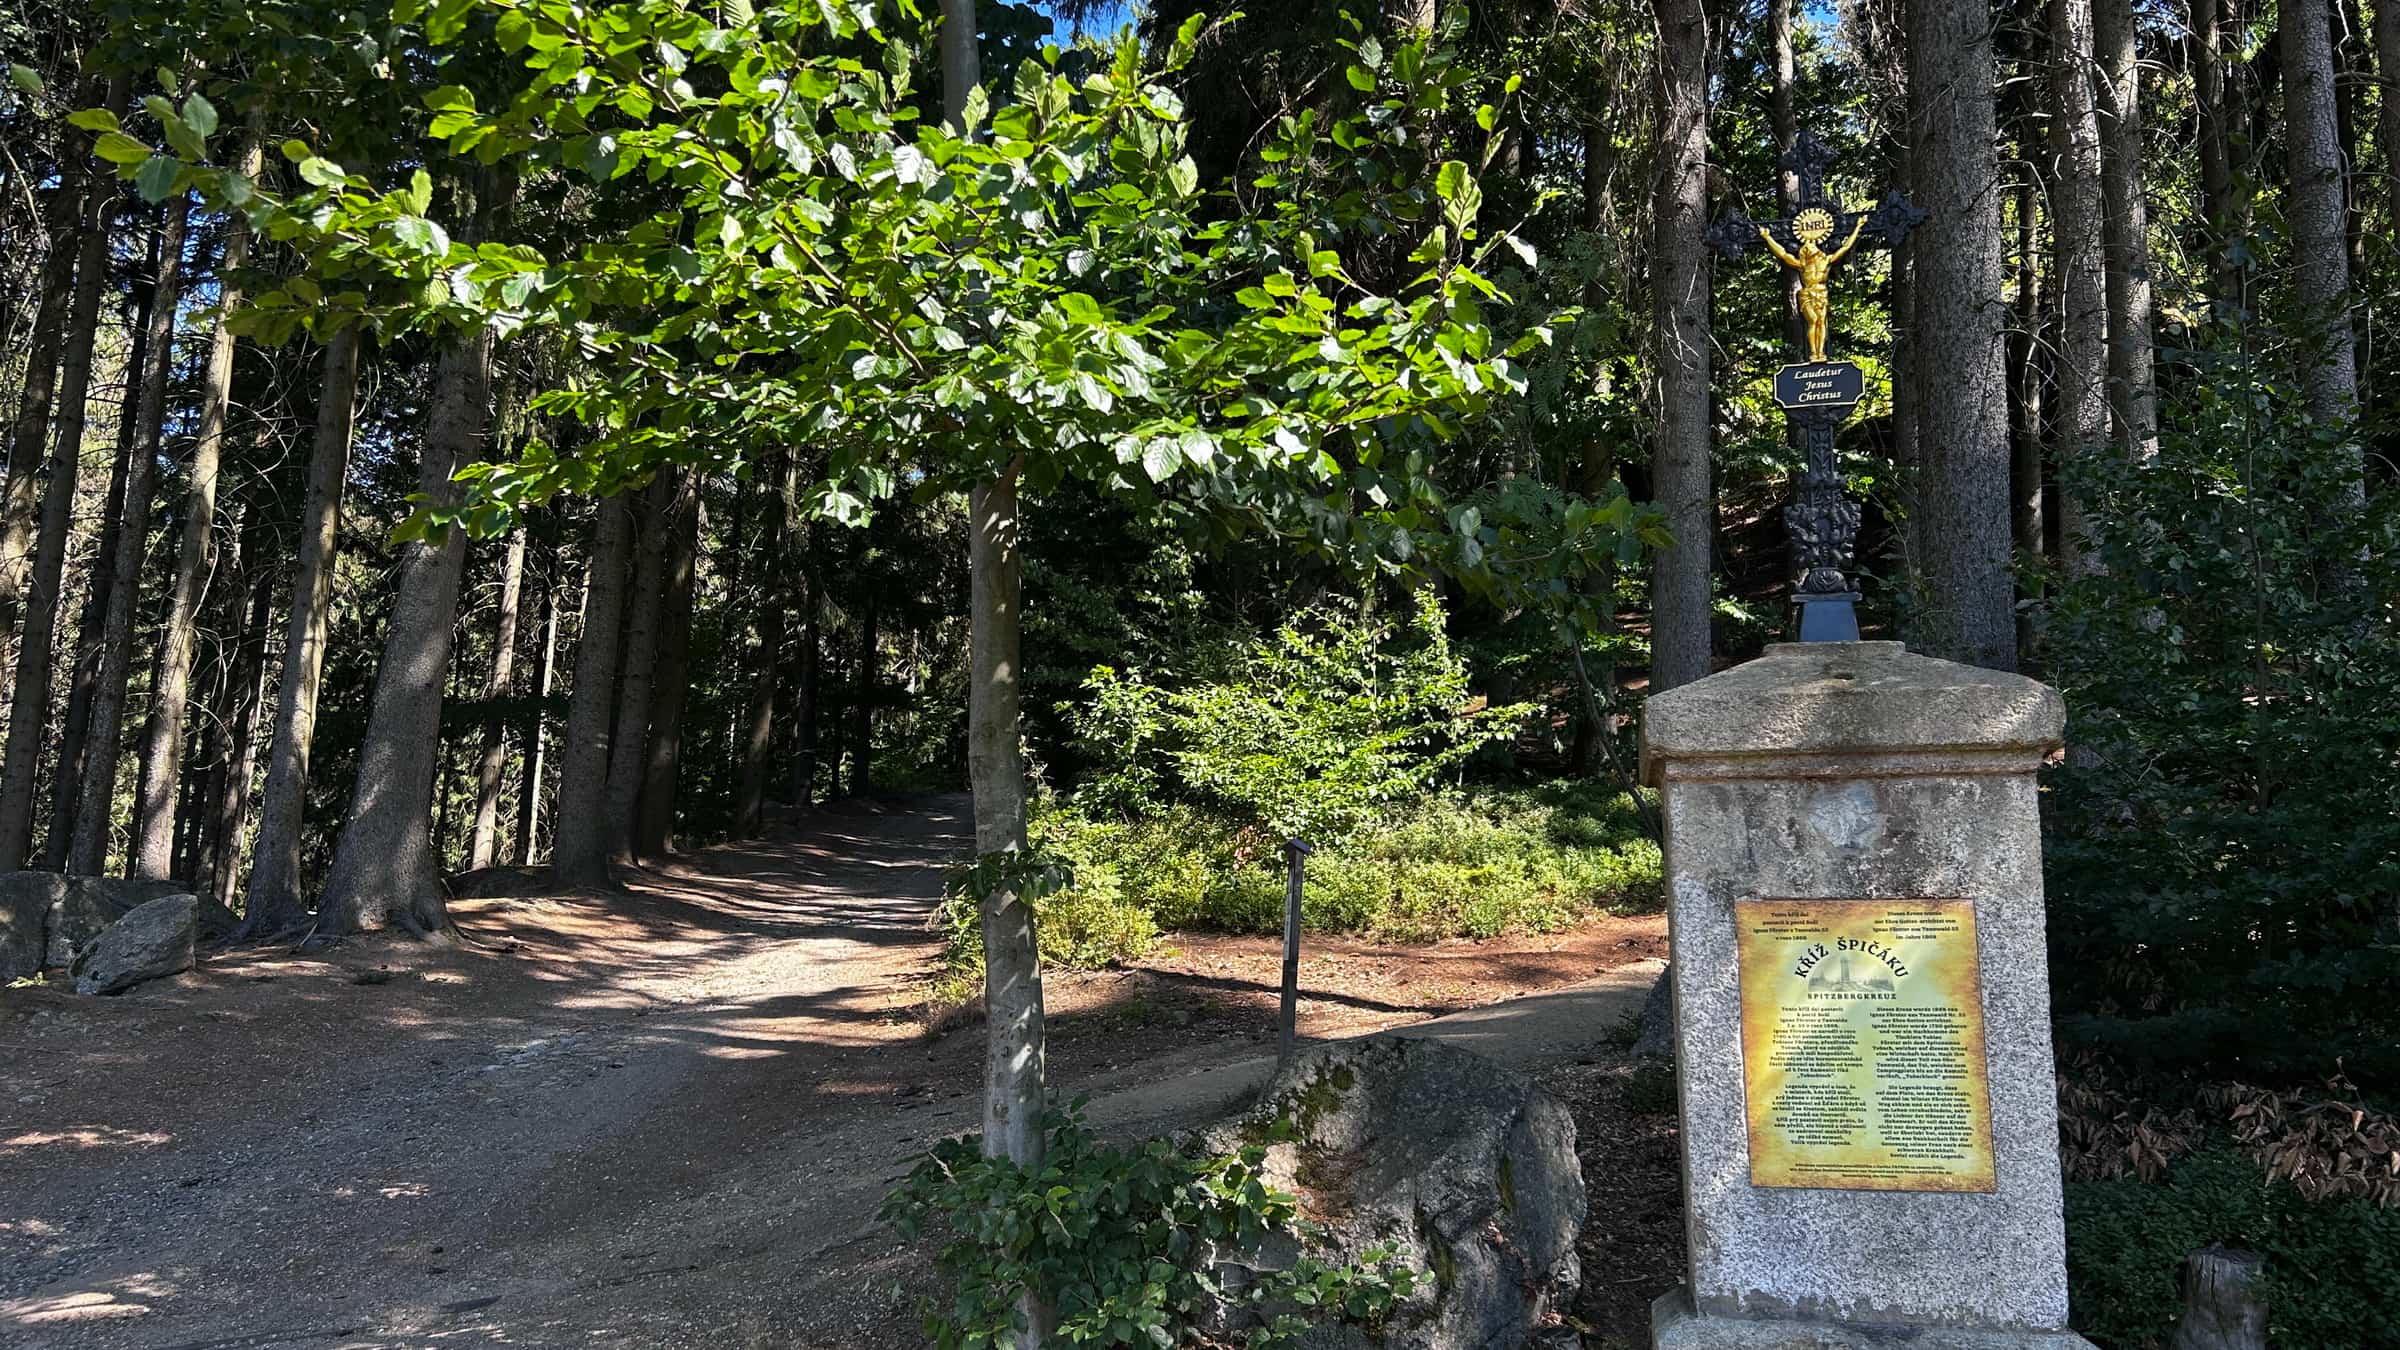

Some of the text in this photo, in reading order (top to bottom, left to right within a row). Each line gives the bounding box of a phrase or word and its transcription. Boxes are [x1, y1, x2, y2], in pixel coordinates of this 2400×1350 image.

[1801, 220, 1824, 231] INRI
[1794, 368, 1843, 379] Laudetur
[1804, 381, 1832, 391] Jesus
[1798, 391, 1841, 402] Christus
[1795, 937, 1909, 978] KŘÍŽ ŠPIČÁKU
